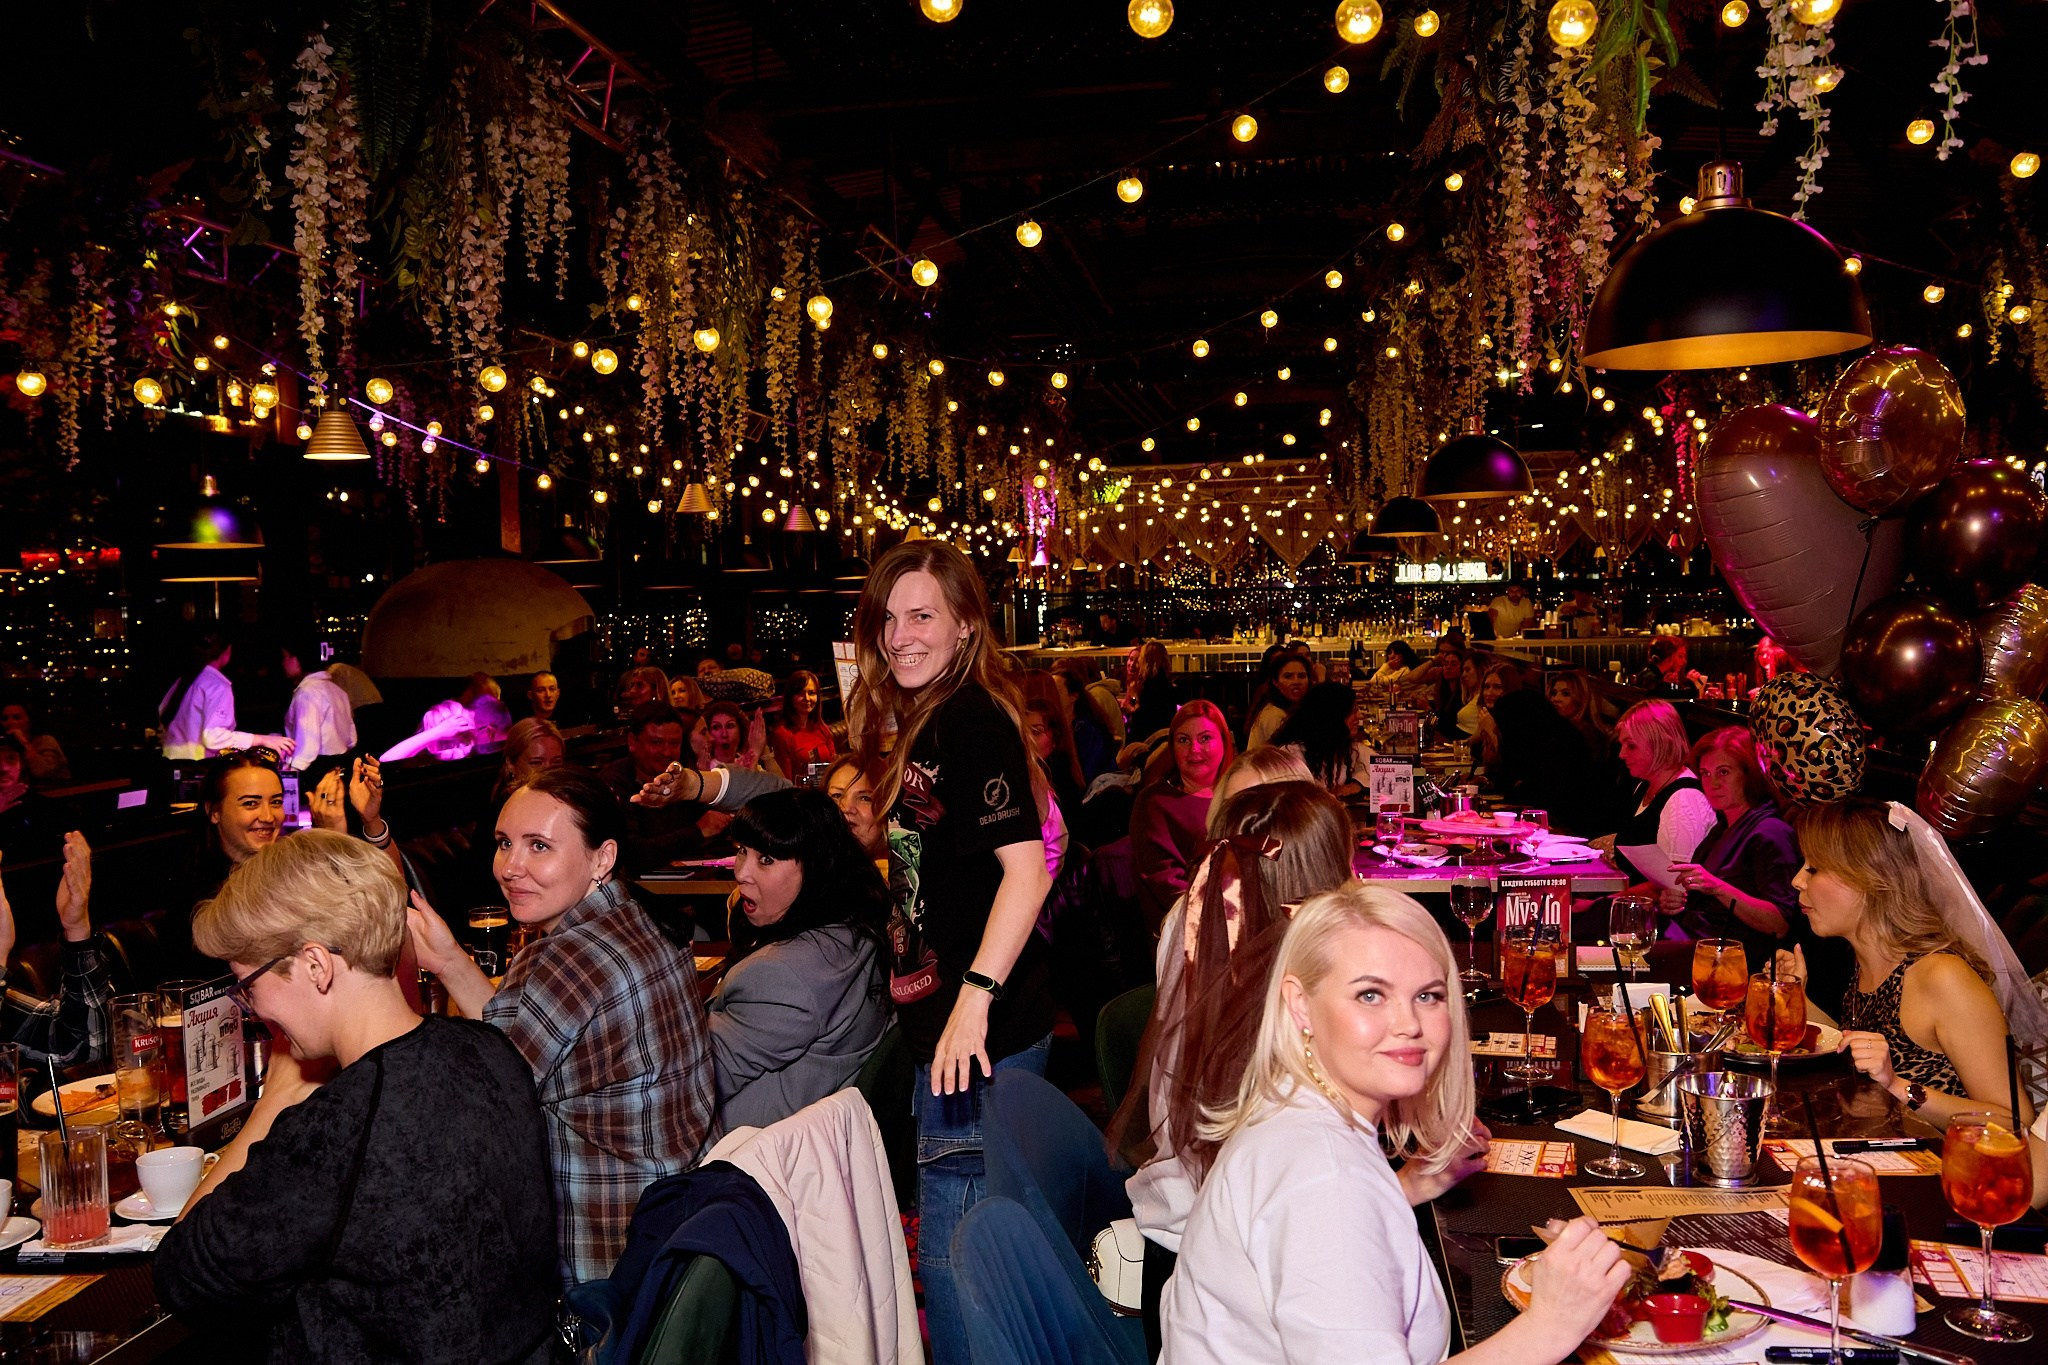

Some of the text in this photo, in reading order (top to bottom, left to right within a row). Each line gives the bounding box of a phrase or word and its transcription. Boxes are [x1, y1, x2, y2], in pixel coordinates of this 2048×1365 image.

[903, 767, 925, 791] OR
[979, 807, 1020, 826] DEAD BRUSH
[1501, 880, 1524, 888] КАЖДУЮ
[1524, 879, 1547, 887] СУББОТУ
[1551, 878, 1567, 887] 20:00
[891, 974, 932, 997] NLOCKED
[187, 1007, 218, 1028] Акция
